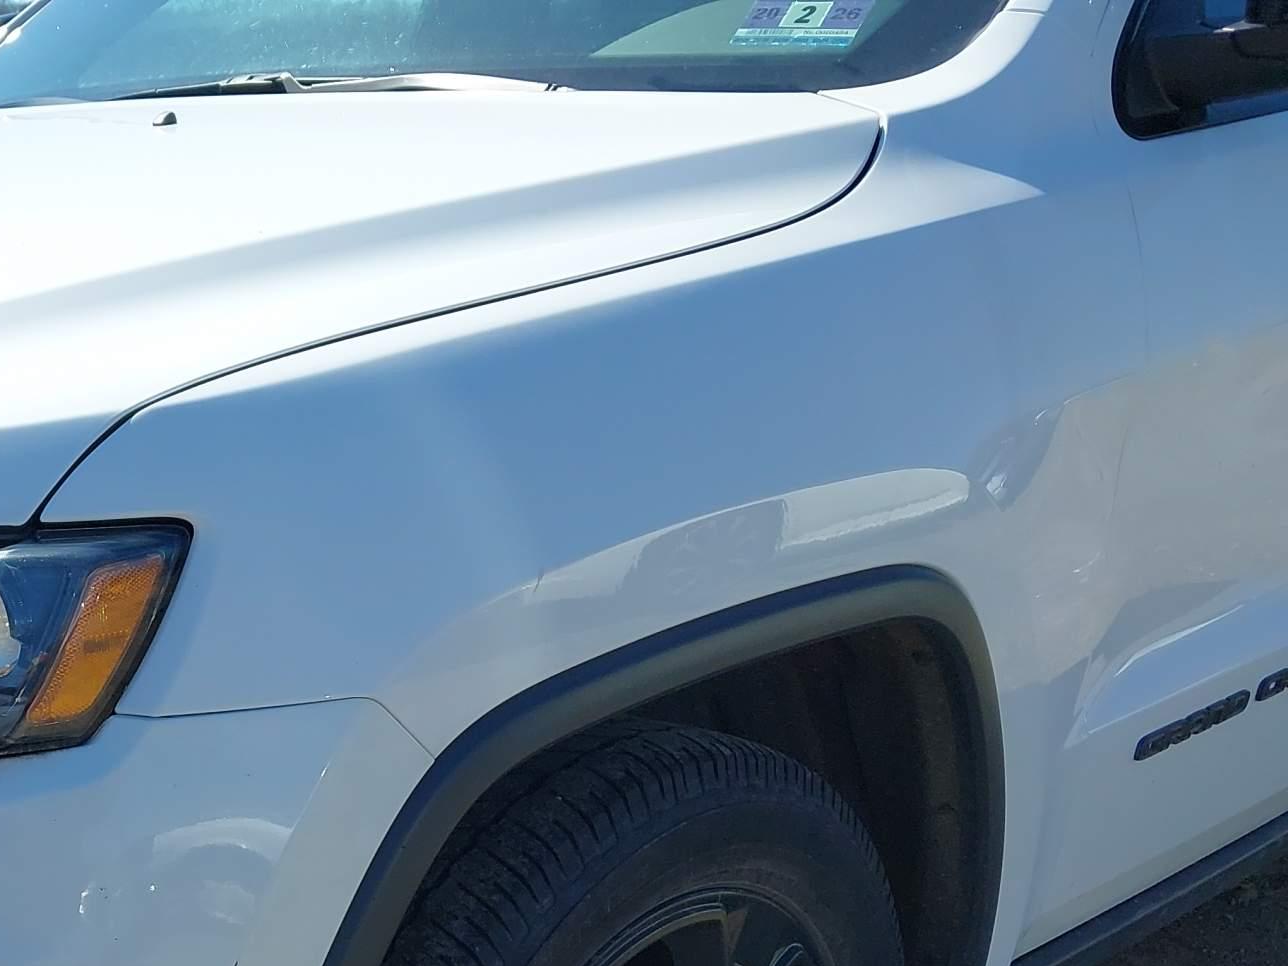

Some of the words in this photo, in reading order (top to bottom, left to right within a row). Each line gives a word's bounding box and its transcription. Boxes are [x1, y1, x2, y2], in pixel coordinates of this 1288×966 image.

[751, 6, 781, 21] 20
[793, 5, 817, 24] 2
[830, 7, 863, 21] 26
[1133, 689, 1251, 761] GRAND
